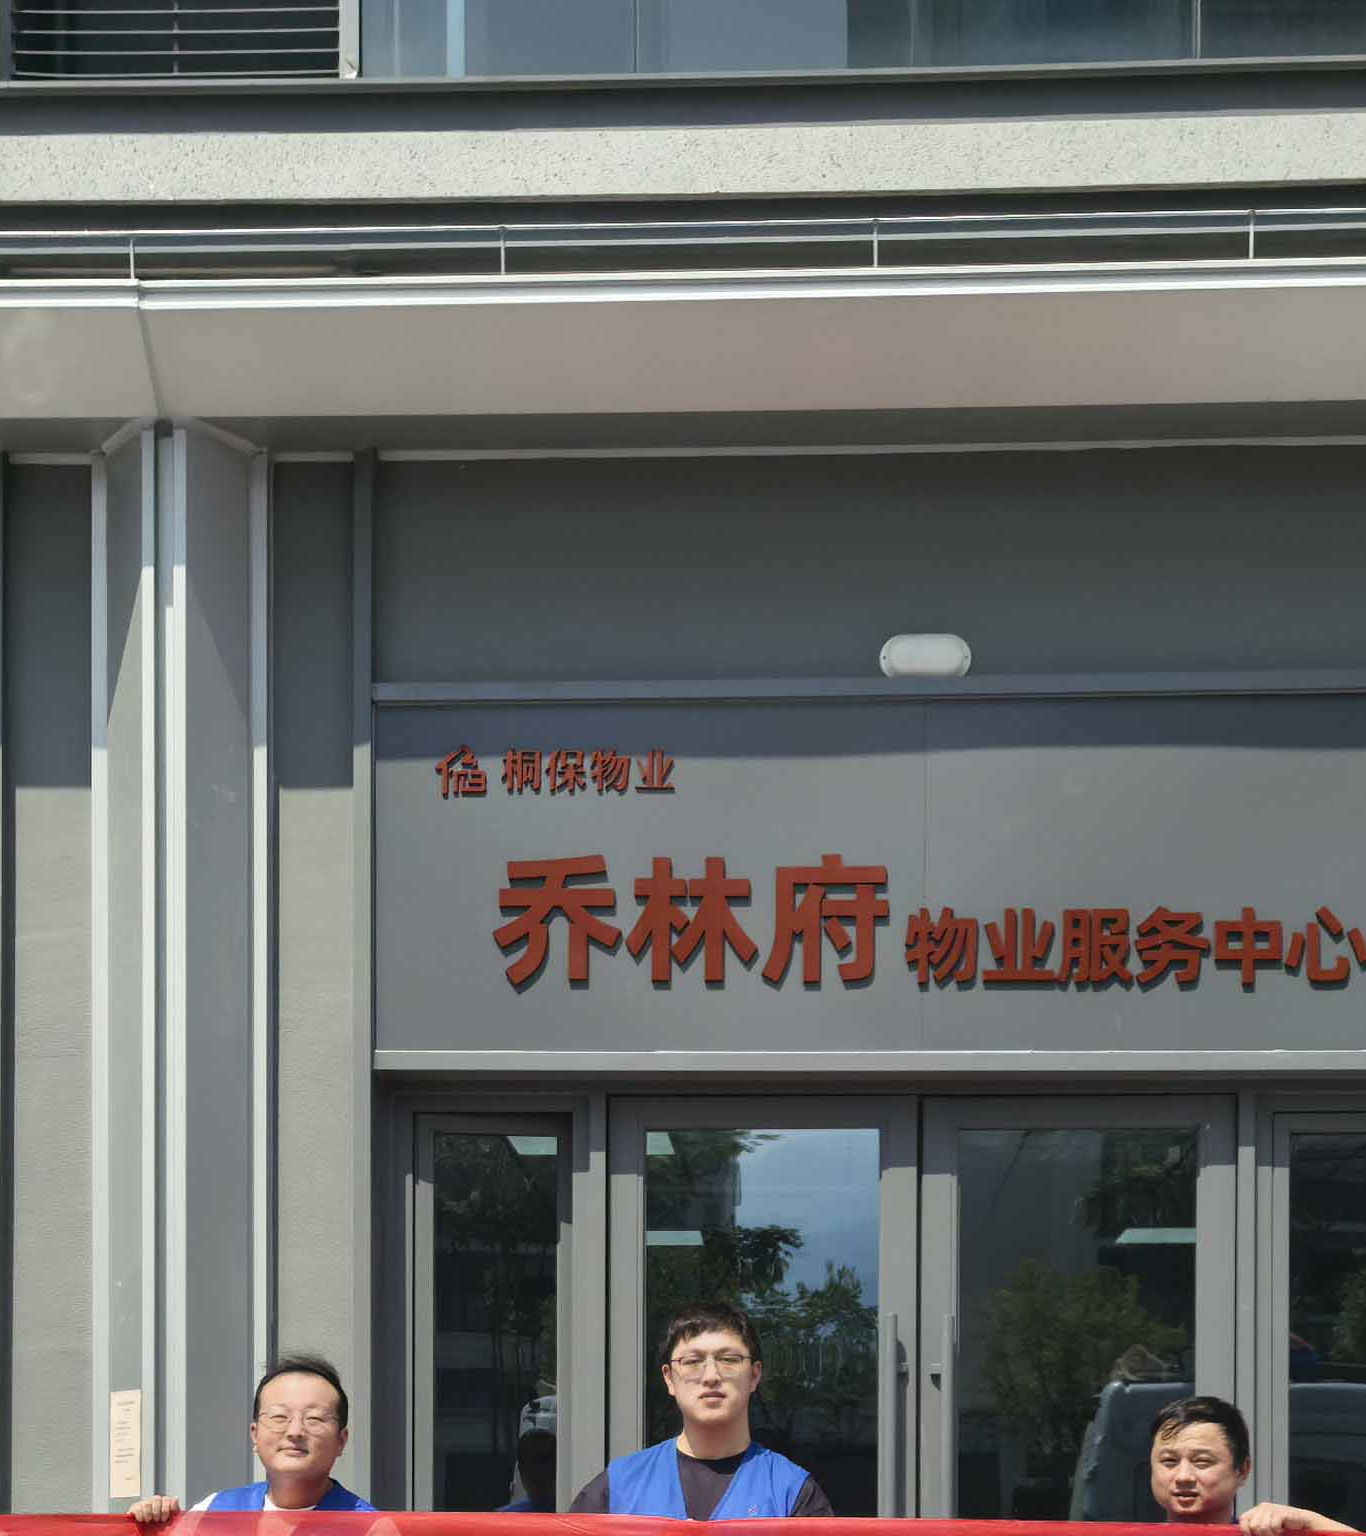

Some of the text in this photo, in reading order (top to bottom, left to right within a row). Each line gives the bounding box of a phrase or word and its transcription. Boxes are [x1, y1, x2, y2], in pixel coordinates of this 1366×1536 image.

[503, 749, 675, 792] 桐保物业
[492, 853, 890, 984] 乔林府
